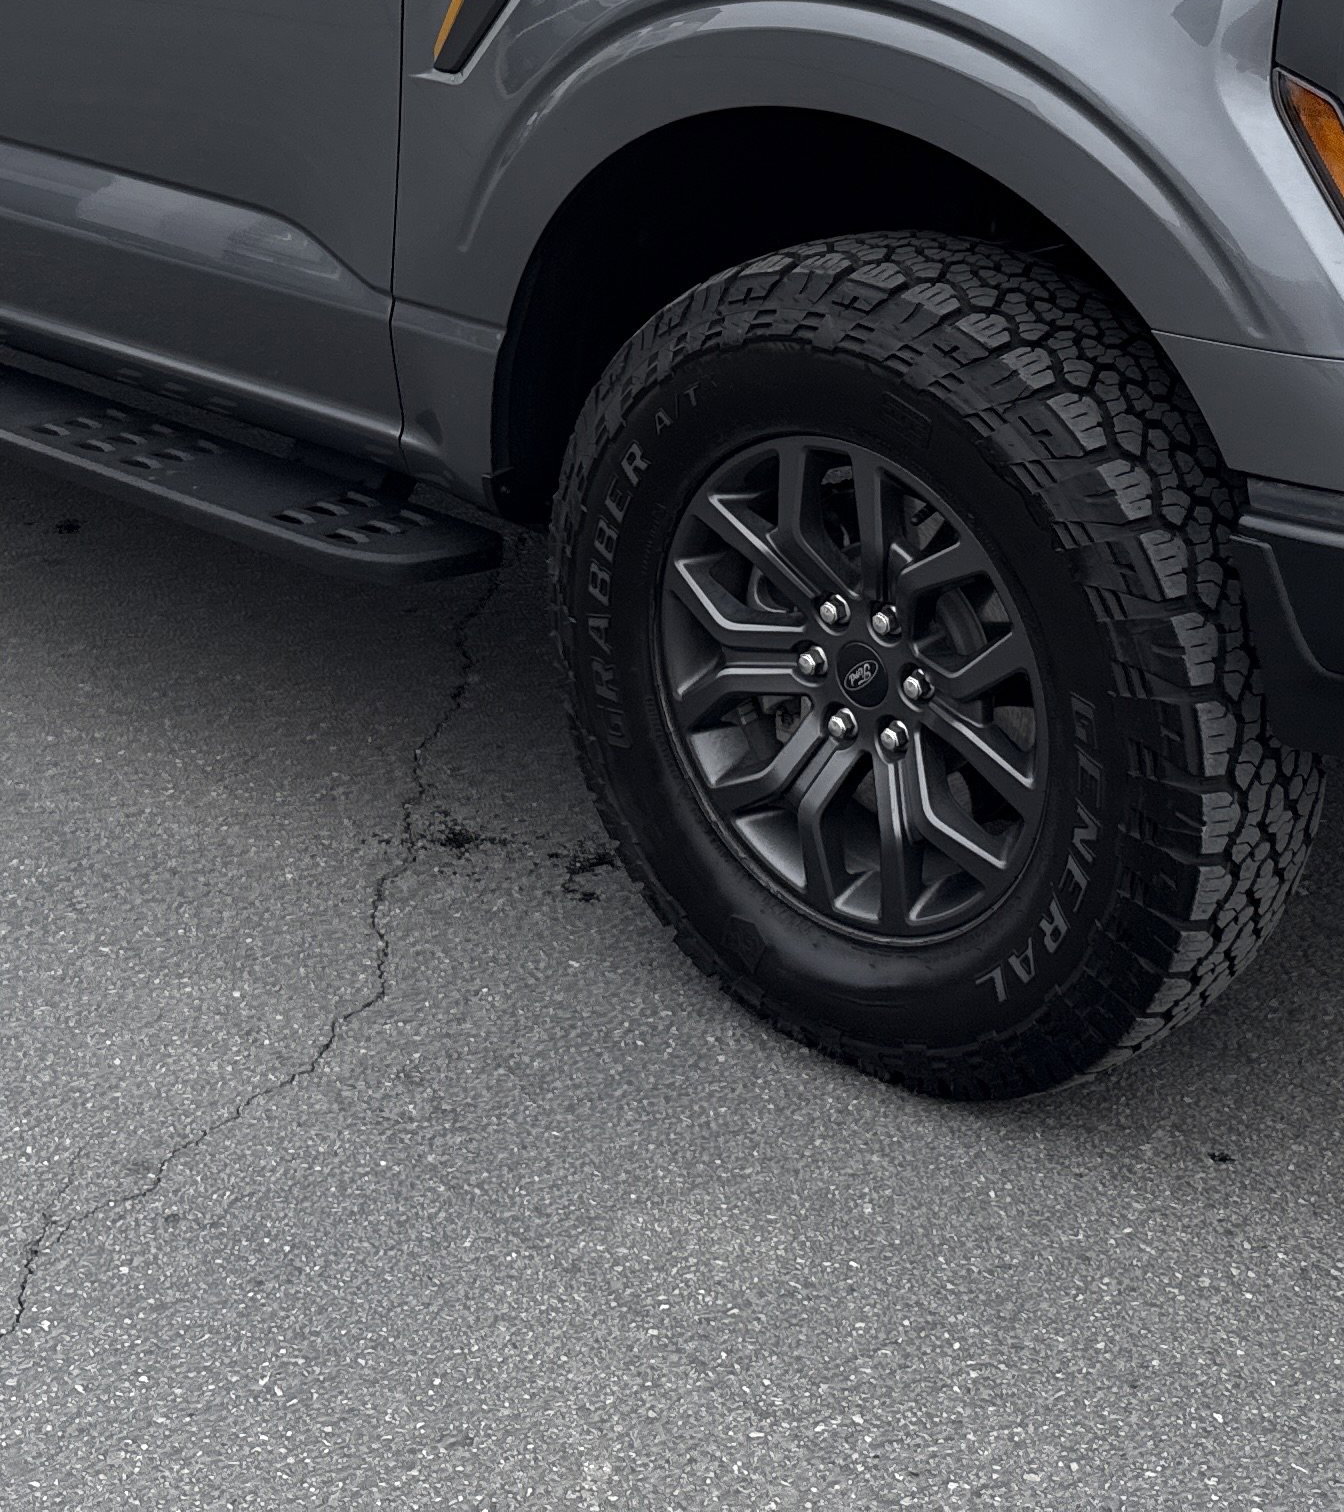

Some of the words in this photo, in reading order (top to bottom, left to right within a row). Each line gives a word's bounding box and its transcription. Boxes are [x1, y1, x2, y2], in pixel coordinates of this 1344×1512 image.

[587, 440, 652, 750] GRABBER
[848, 663, 872, 687] Ford
[975, 690, 1106, 1003] GENERAL
